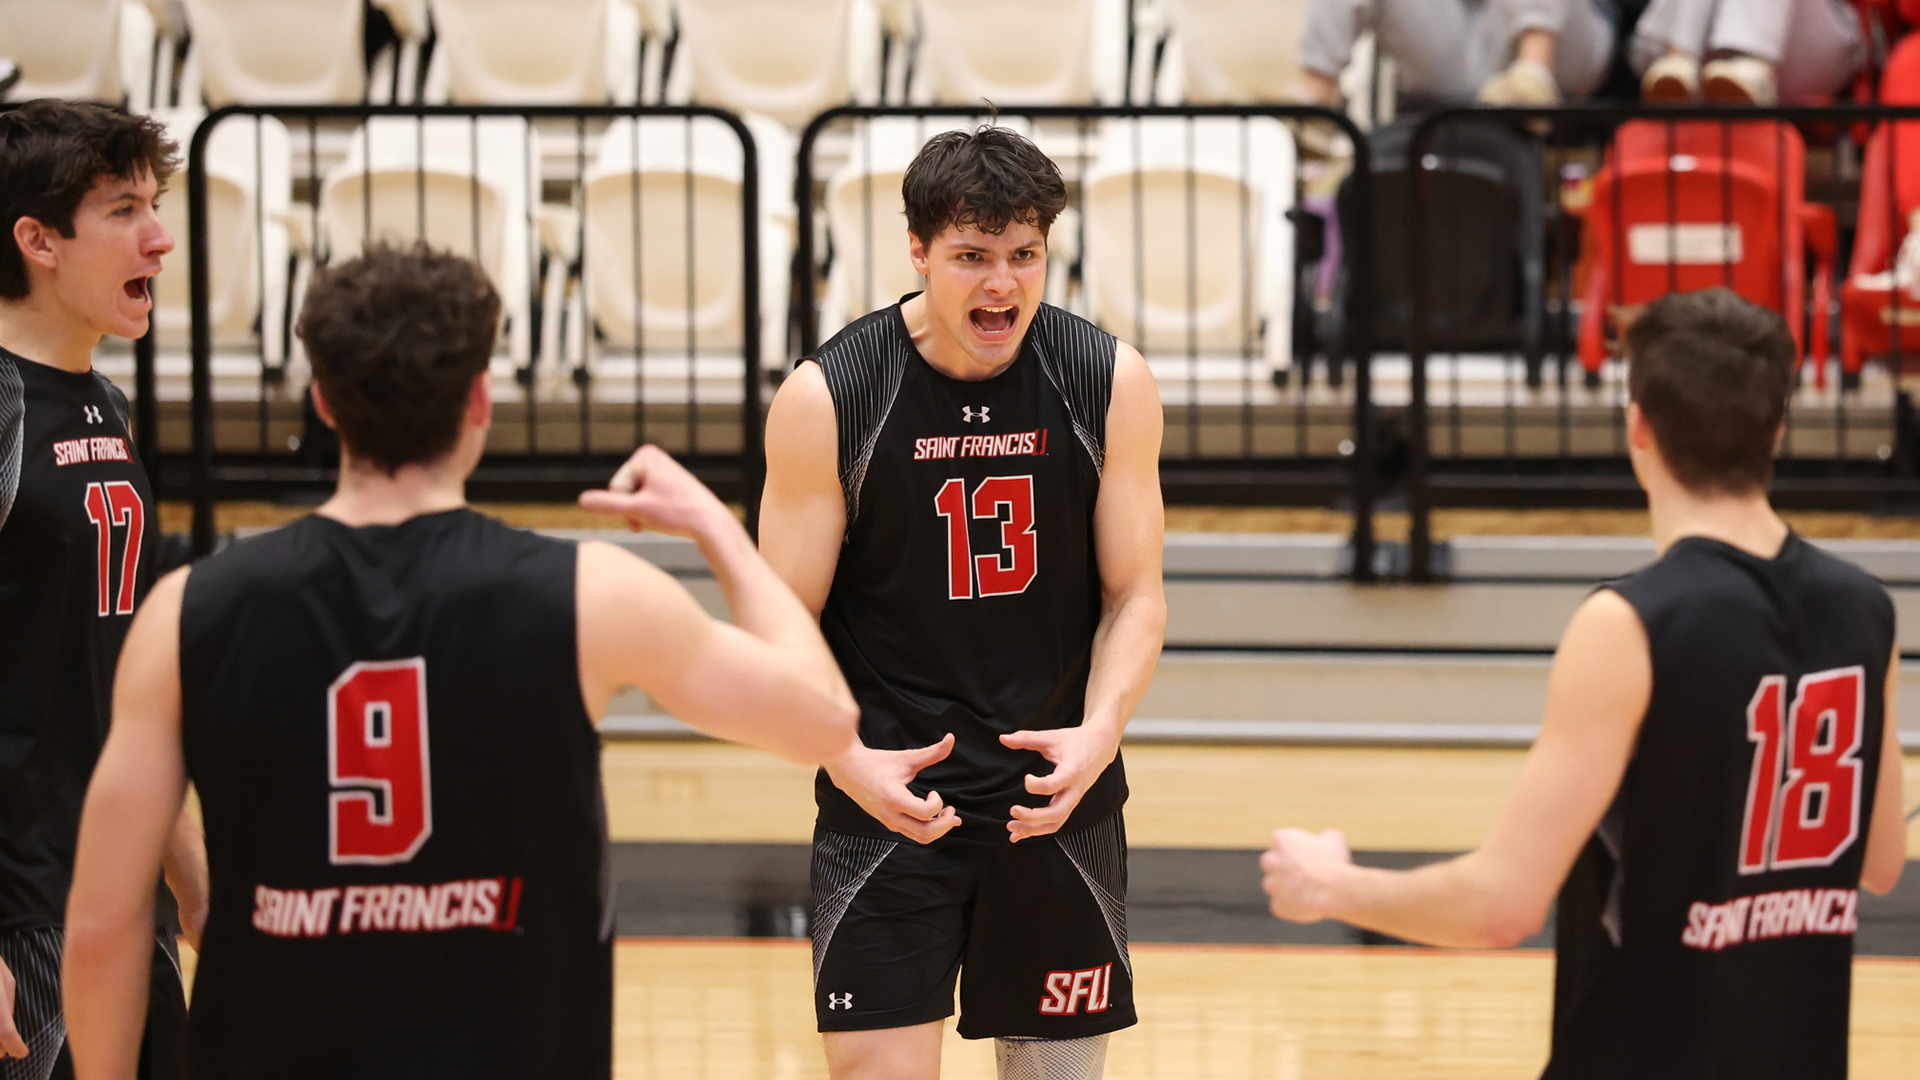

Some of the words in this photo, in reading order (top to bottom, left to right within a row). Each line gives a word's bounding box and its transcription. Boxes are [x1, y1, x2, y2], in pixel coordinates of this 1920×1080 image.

[53, 437, 90, 466] SAINT
[914, 435, 961, 460] SAINT
[84, 480, 144, 617] 17
[934, 474, 1038, 600] 13
[327, 655, 432, 866] 9
[1738, 664, 1865, 876] 18
[252, 884, 341, 938] SAINT
[1681, 895, 1753, 951] SANT
[1747, 887, 1858, 941] FRANCI
[1039, 961, 1113, 1016] SFU
